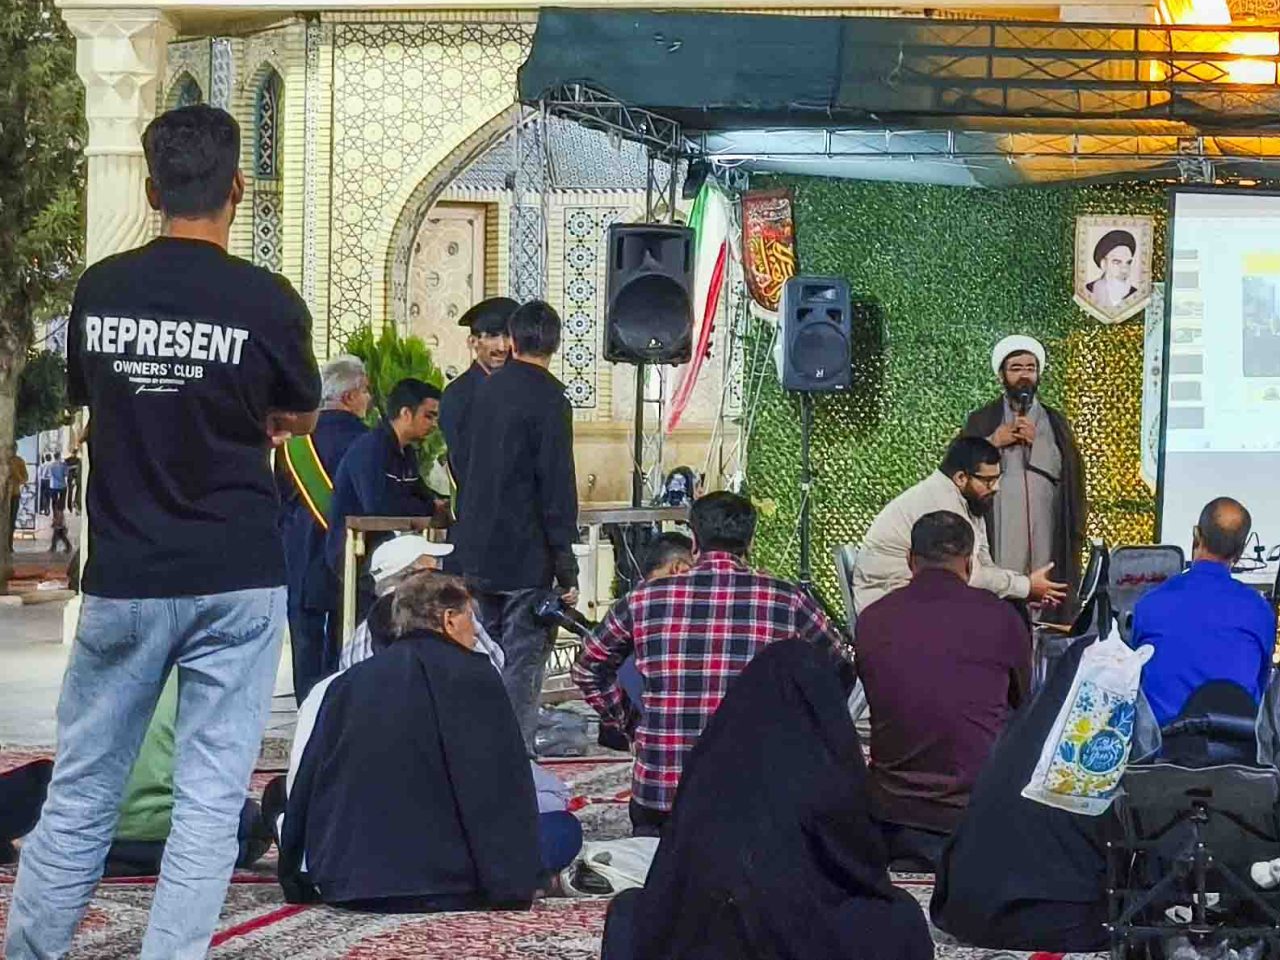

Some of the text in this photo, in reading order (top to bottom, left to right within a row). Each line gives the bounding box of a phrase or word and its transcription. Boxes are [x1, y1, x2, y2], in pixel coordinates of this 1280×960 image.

[86, 315, 249, 365] REPRESENT
[113, 359, 204, 379] OWNERS' CLUB
